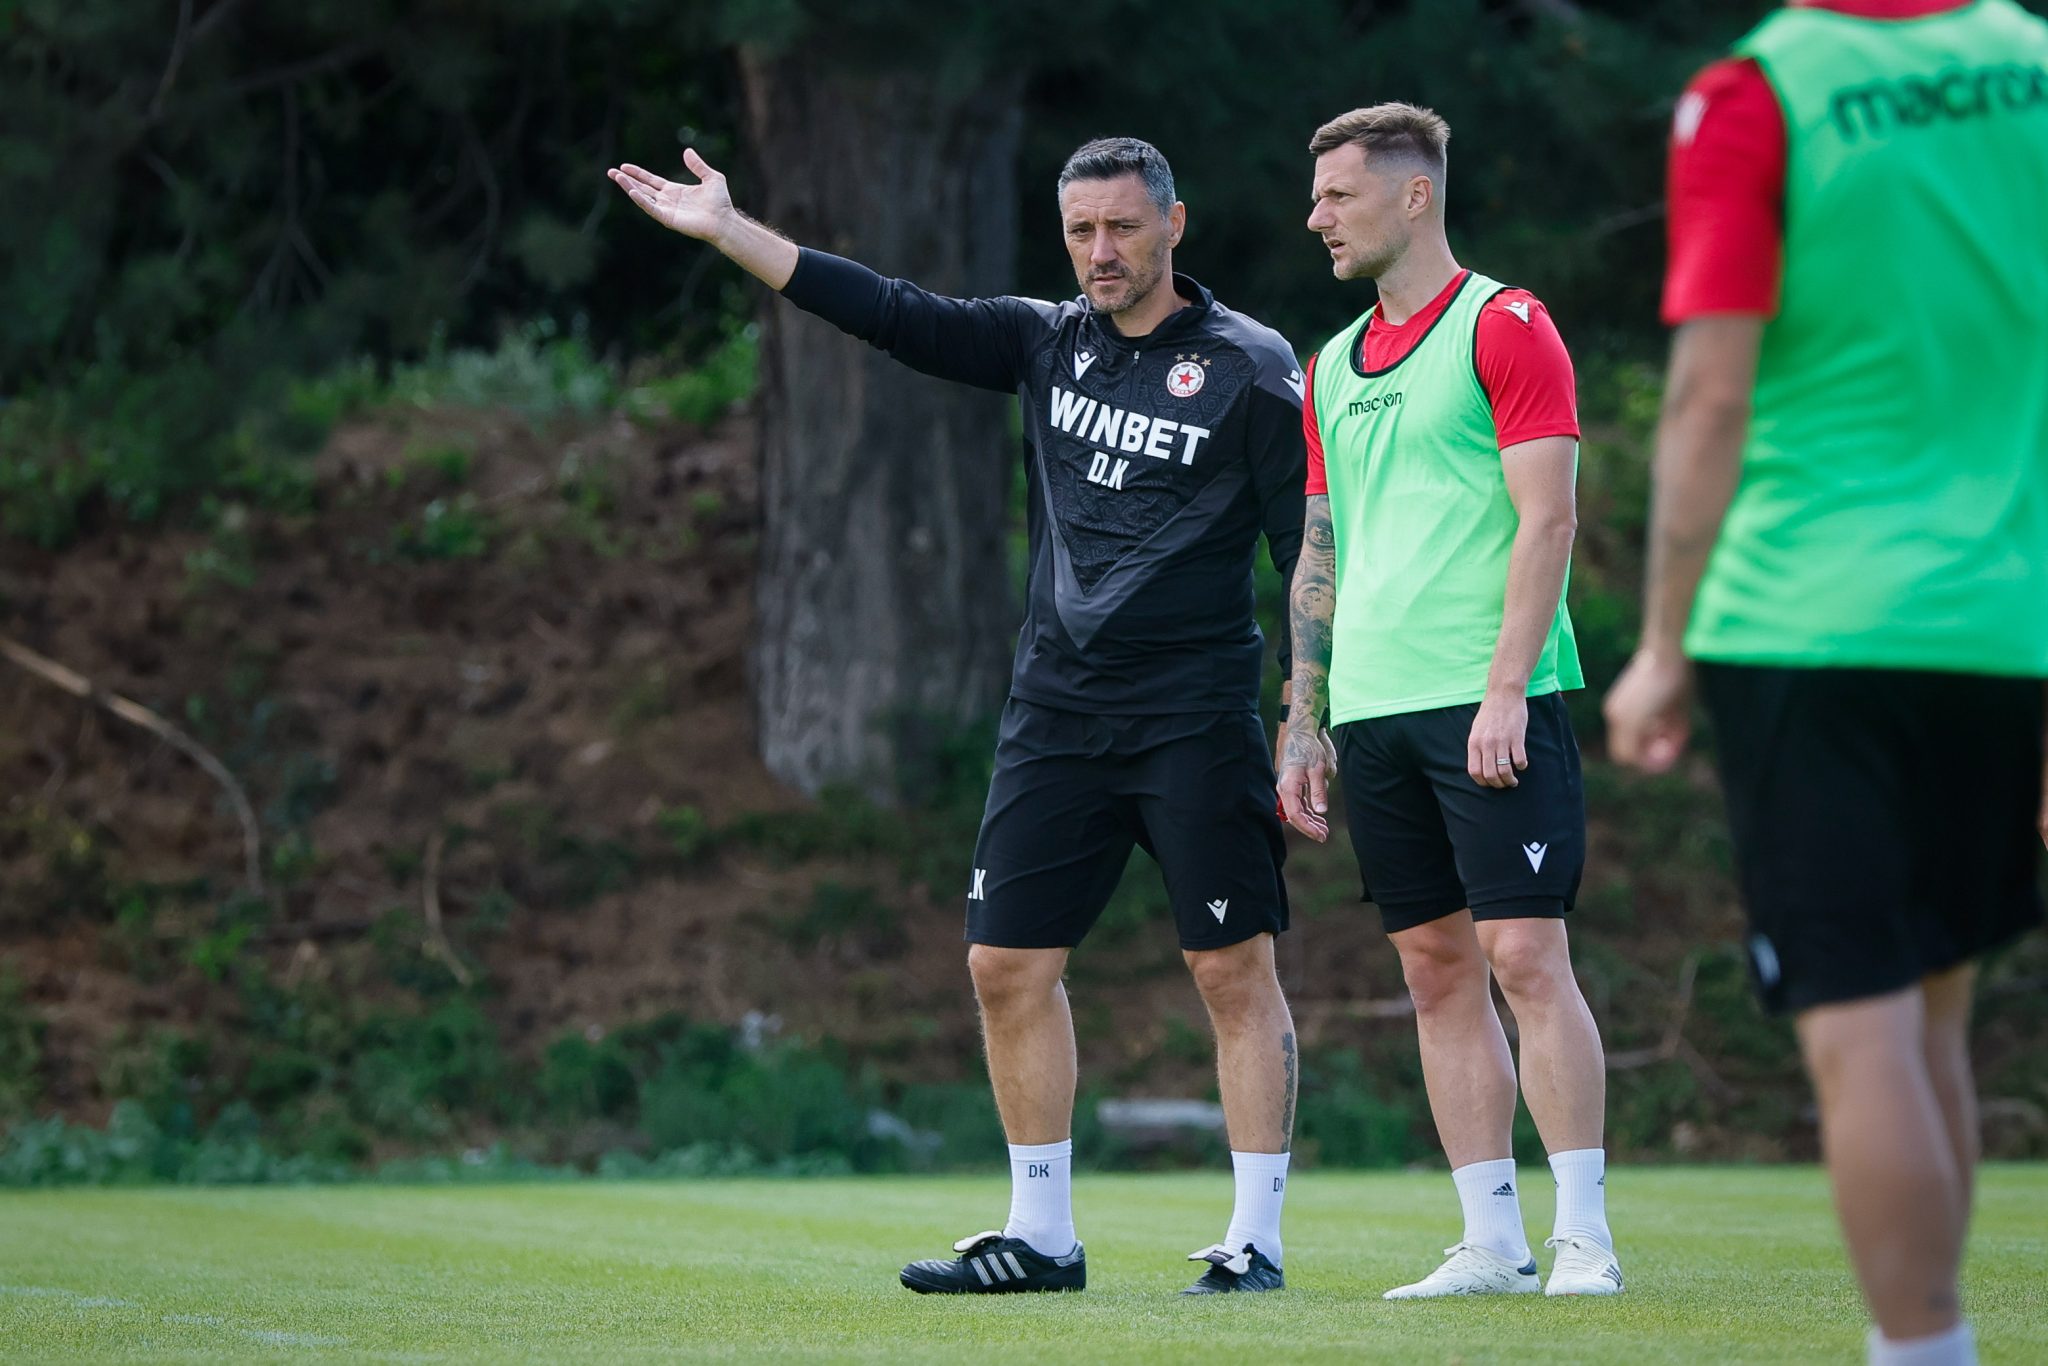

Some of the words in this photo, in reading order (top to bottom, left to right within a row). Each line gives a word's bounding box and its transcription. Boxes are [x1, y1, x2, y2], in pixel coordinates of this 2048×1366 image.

[1832, 66, 2047, 141] macro
[1349, 392, 1402, 416] macron
[1051, 386, 1210, 465] WINBET
[1087, 451, 1130, 491] D.K
[968, 868, 987, 900] .K
[1029, 1163, 1049, 1178] DK
